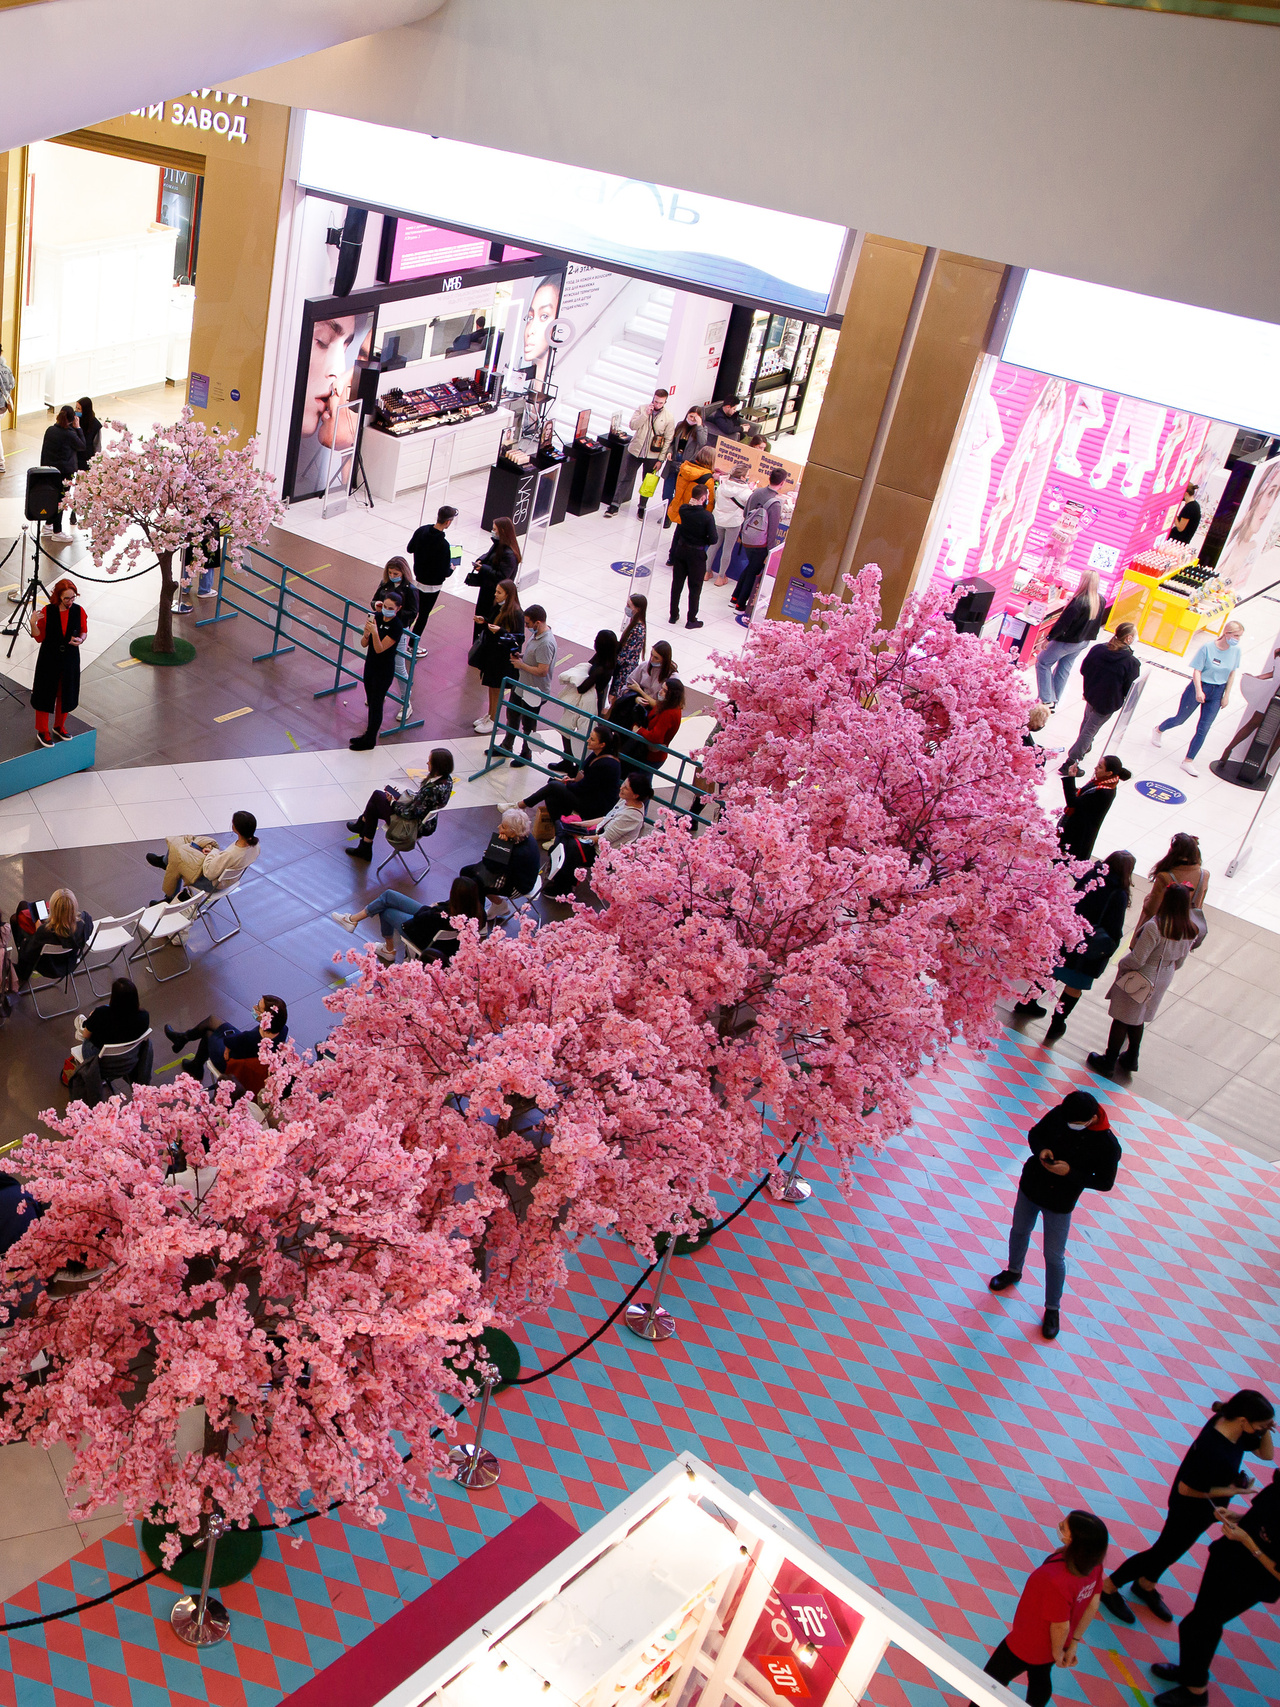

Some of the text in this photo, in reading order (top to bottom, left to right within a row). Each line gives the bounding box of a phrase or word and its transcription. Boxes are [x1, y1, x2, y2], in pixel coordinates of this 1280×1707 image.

[171, 102, 248, 144] ЗАВОД
[441, 275, 463, 292] NARS
[512, 475, 534, 525] NARS
